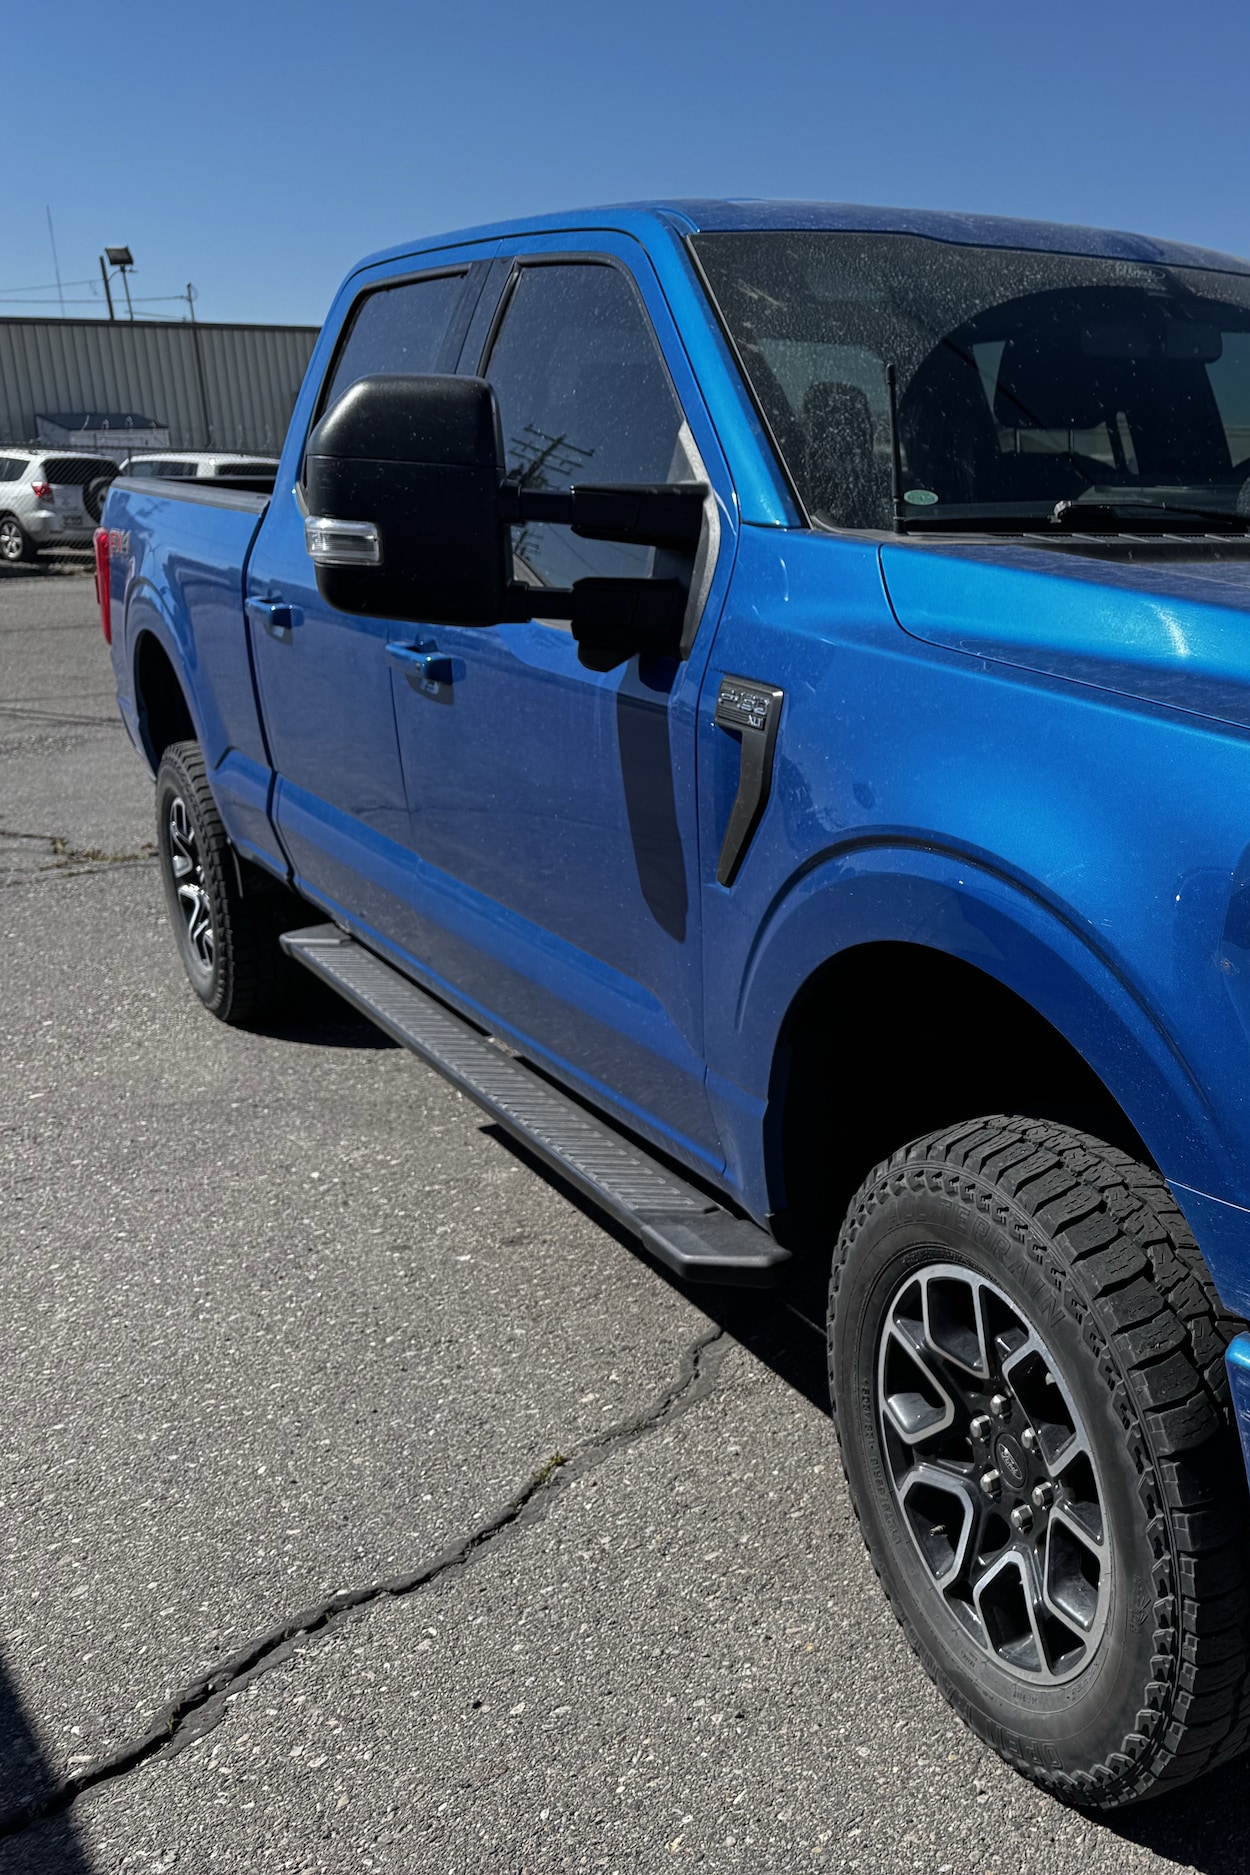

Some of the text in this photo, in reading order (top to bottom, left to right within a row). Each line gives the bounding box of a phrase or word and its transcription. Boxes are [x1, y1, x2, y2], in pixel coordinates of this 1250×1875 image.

[109, 528, 131, 557] FX4
[748, 715, 764, 727] XLT
[940, 1195, 1067, 1329] TERRAIN
[985, 1716, 1064, 1771] OPEN
